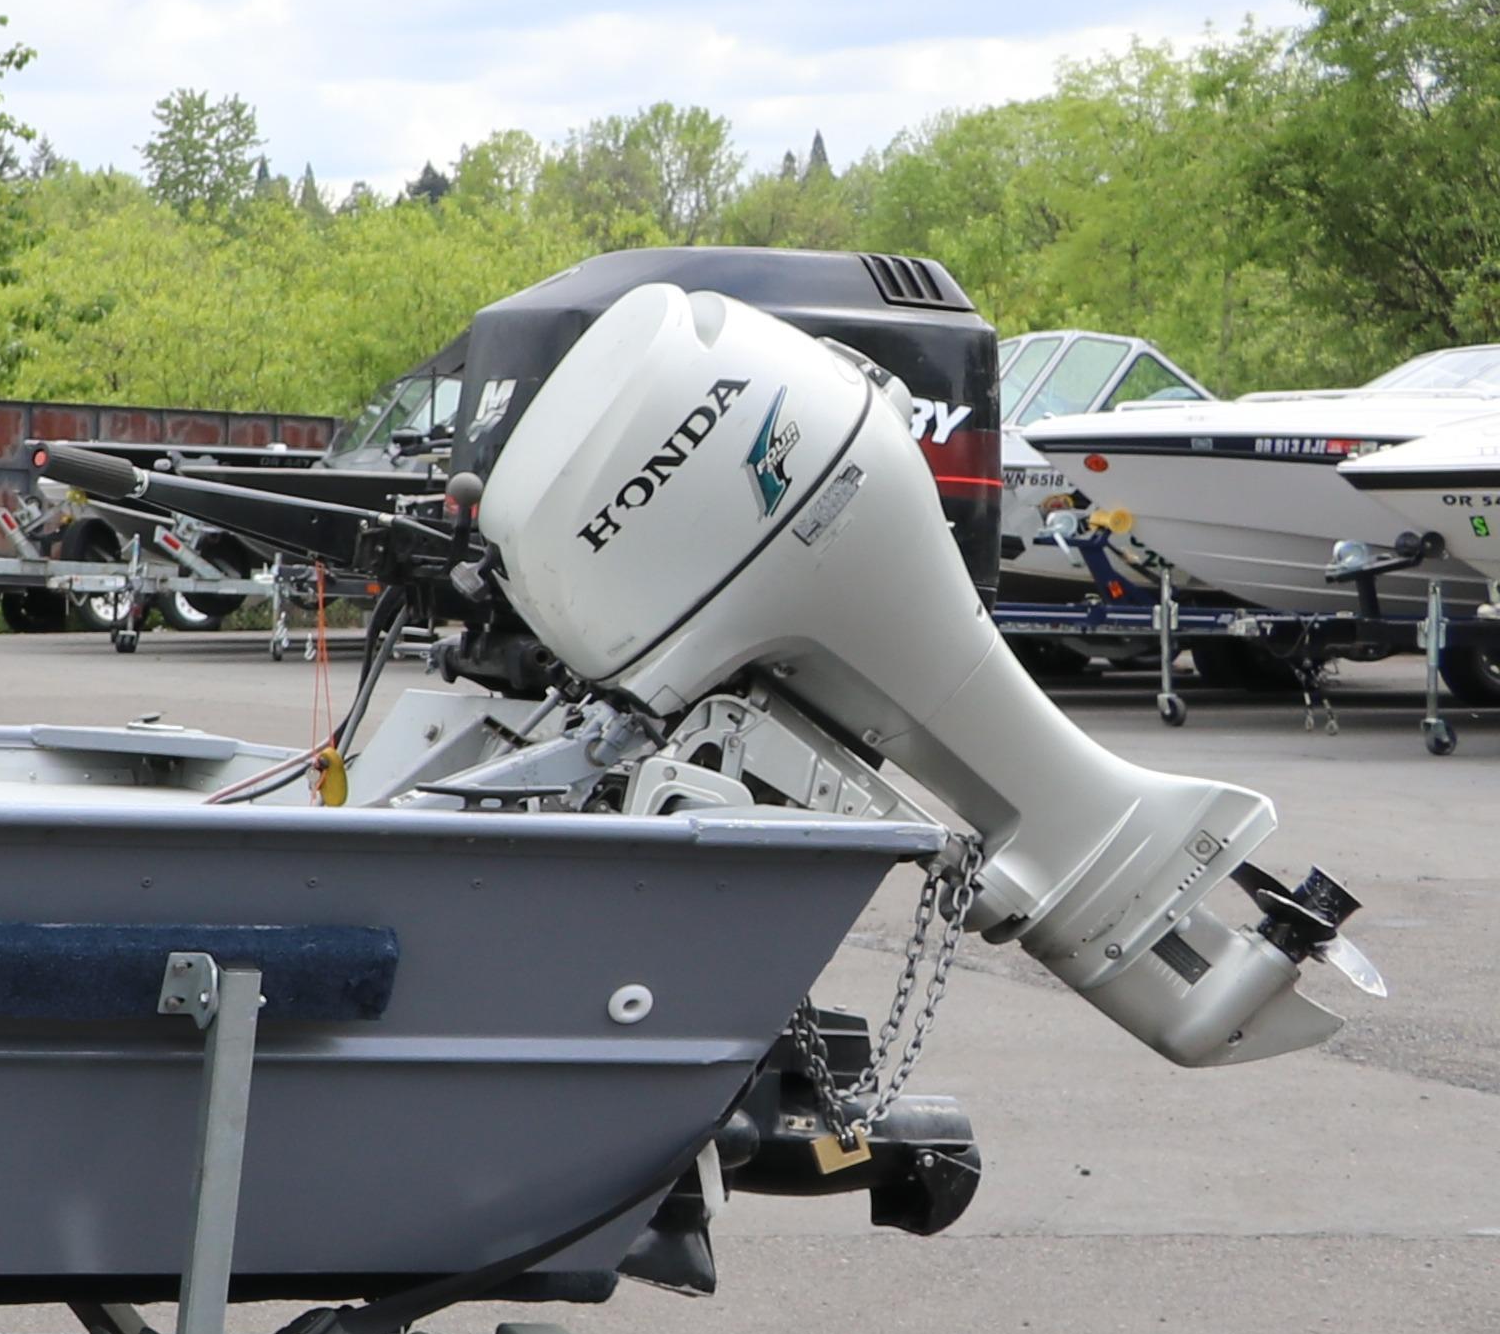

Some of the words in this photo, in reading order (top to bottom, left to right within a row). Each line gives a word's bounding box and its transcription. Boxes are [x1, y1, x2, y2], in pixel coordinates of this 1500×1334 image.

[576, 378, 750, 553] HONDA
[757, 422, 800, 475] FOUR
[1442, 495, 1473, 507] OR
